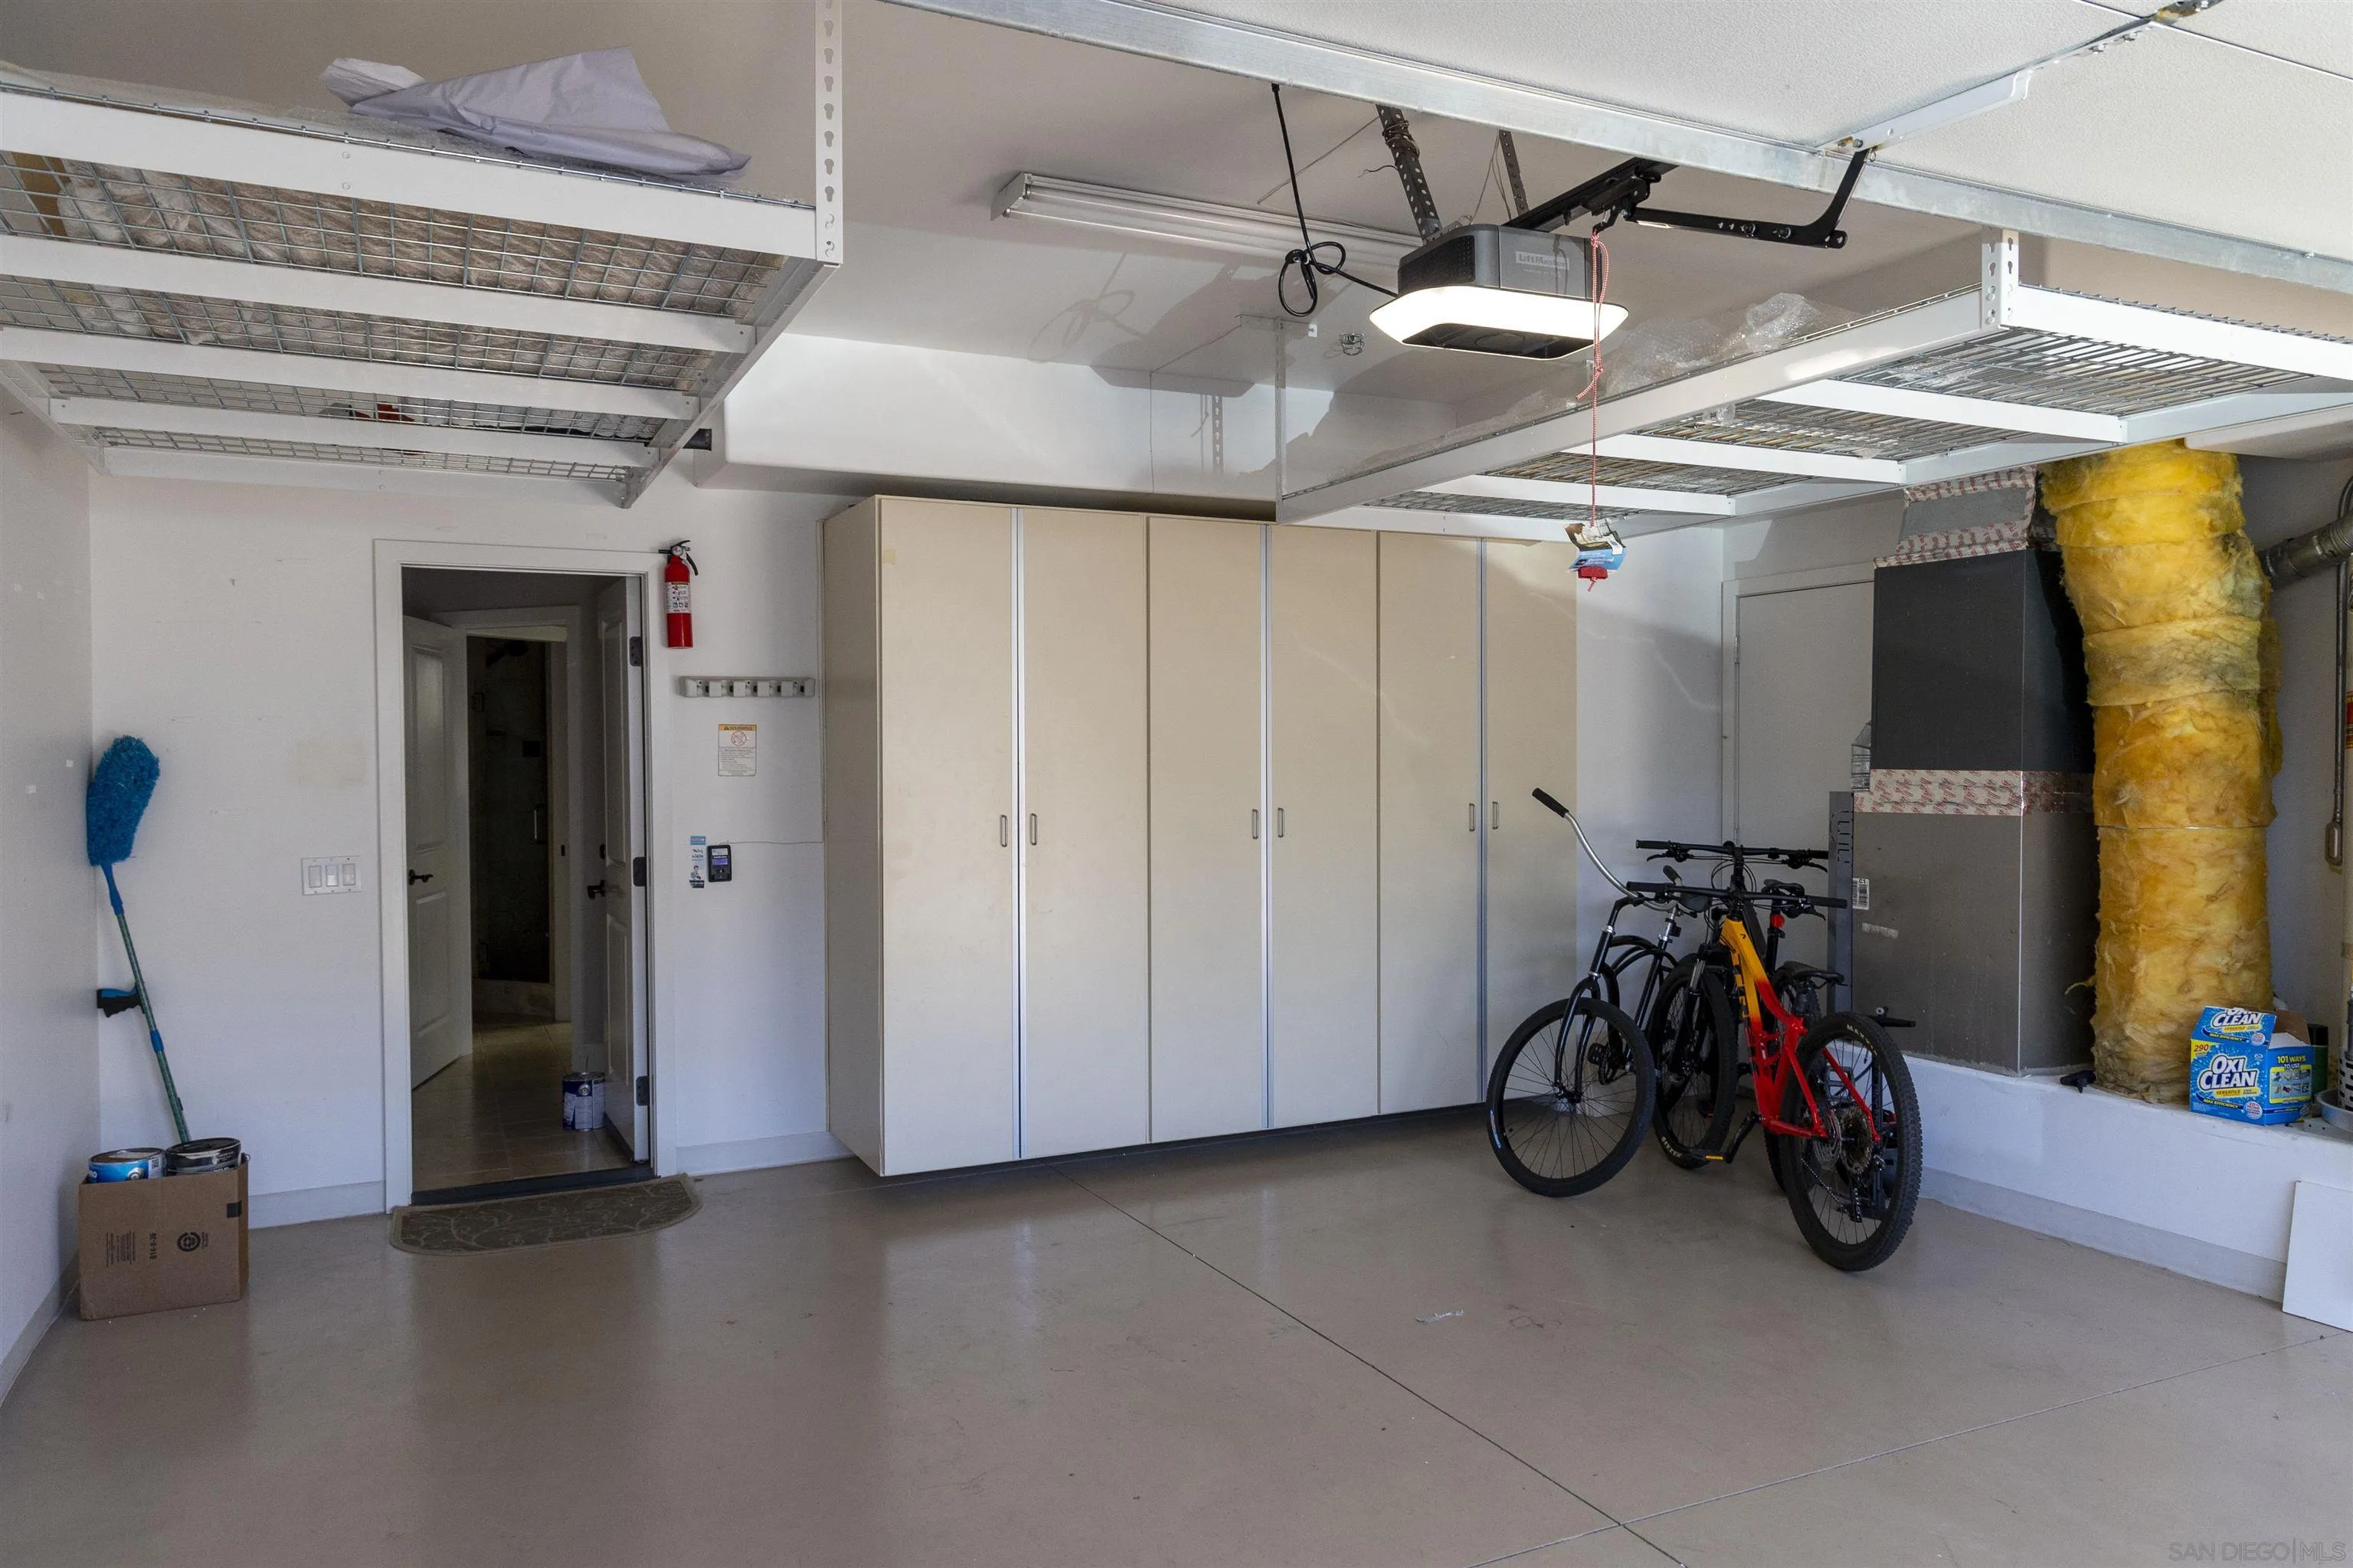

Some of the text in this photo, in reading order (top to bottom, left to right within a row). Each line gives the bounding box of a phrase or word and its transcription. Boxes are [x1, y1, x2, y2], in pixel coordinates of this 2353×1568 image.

[2212, 1013, 2263, 1027] CLEAN
[2194, 1044, 2209, 1052] 290
[2211, 1055, 2246, 1075] OXI
[2277, 1055, 2306, 1064] 101 WAYS
[2198, 1070, 2257, 1091] CLEAN
[2214, 1100, 2239, 1108] EFFICIENCY
